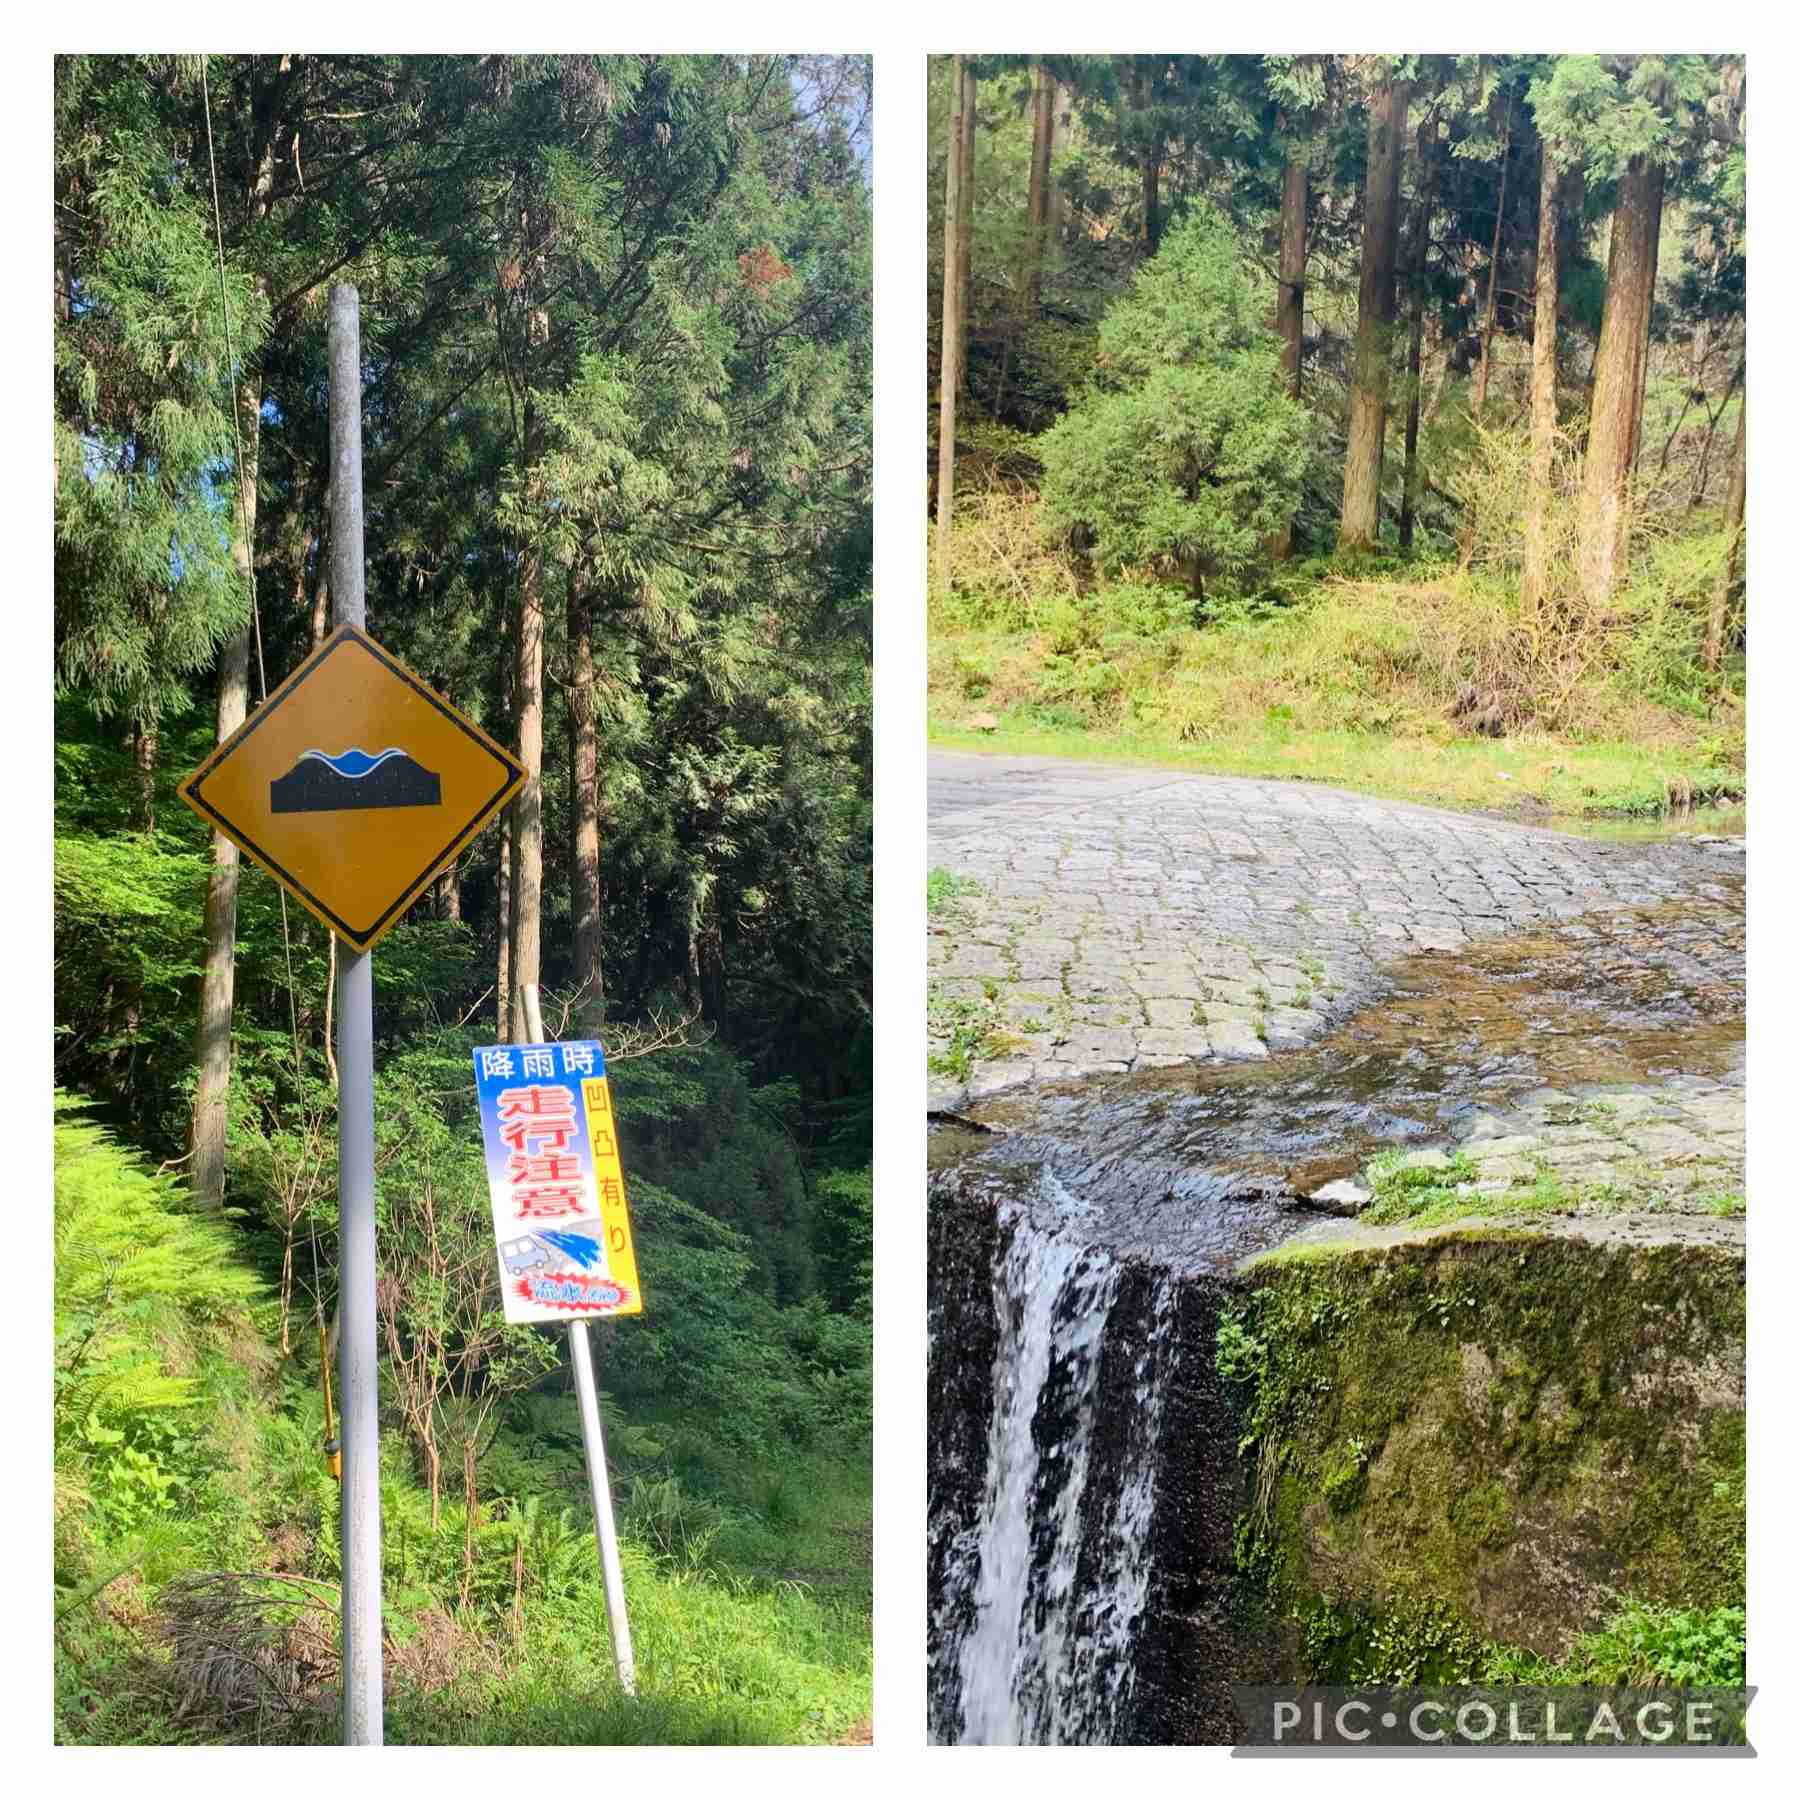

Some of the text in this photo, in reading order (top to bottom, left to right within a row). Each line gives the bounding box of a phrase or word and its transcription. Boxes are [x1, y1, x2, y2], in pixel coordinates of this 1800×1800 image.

[481, 1047, 595, 1081] 降雨時
[498, 1086, 586, 1219] 走行注意
[586, 1085, 626, 1253] 凹凸有り
